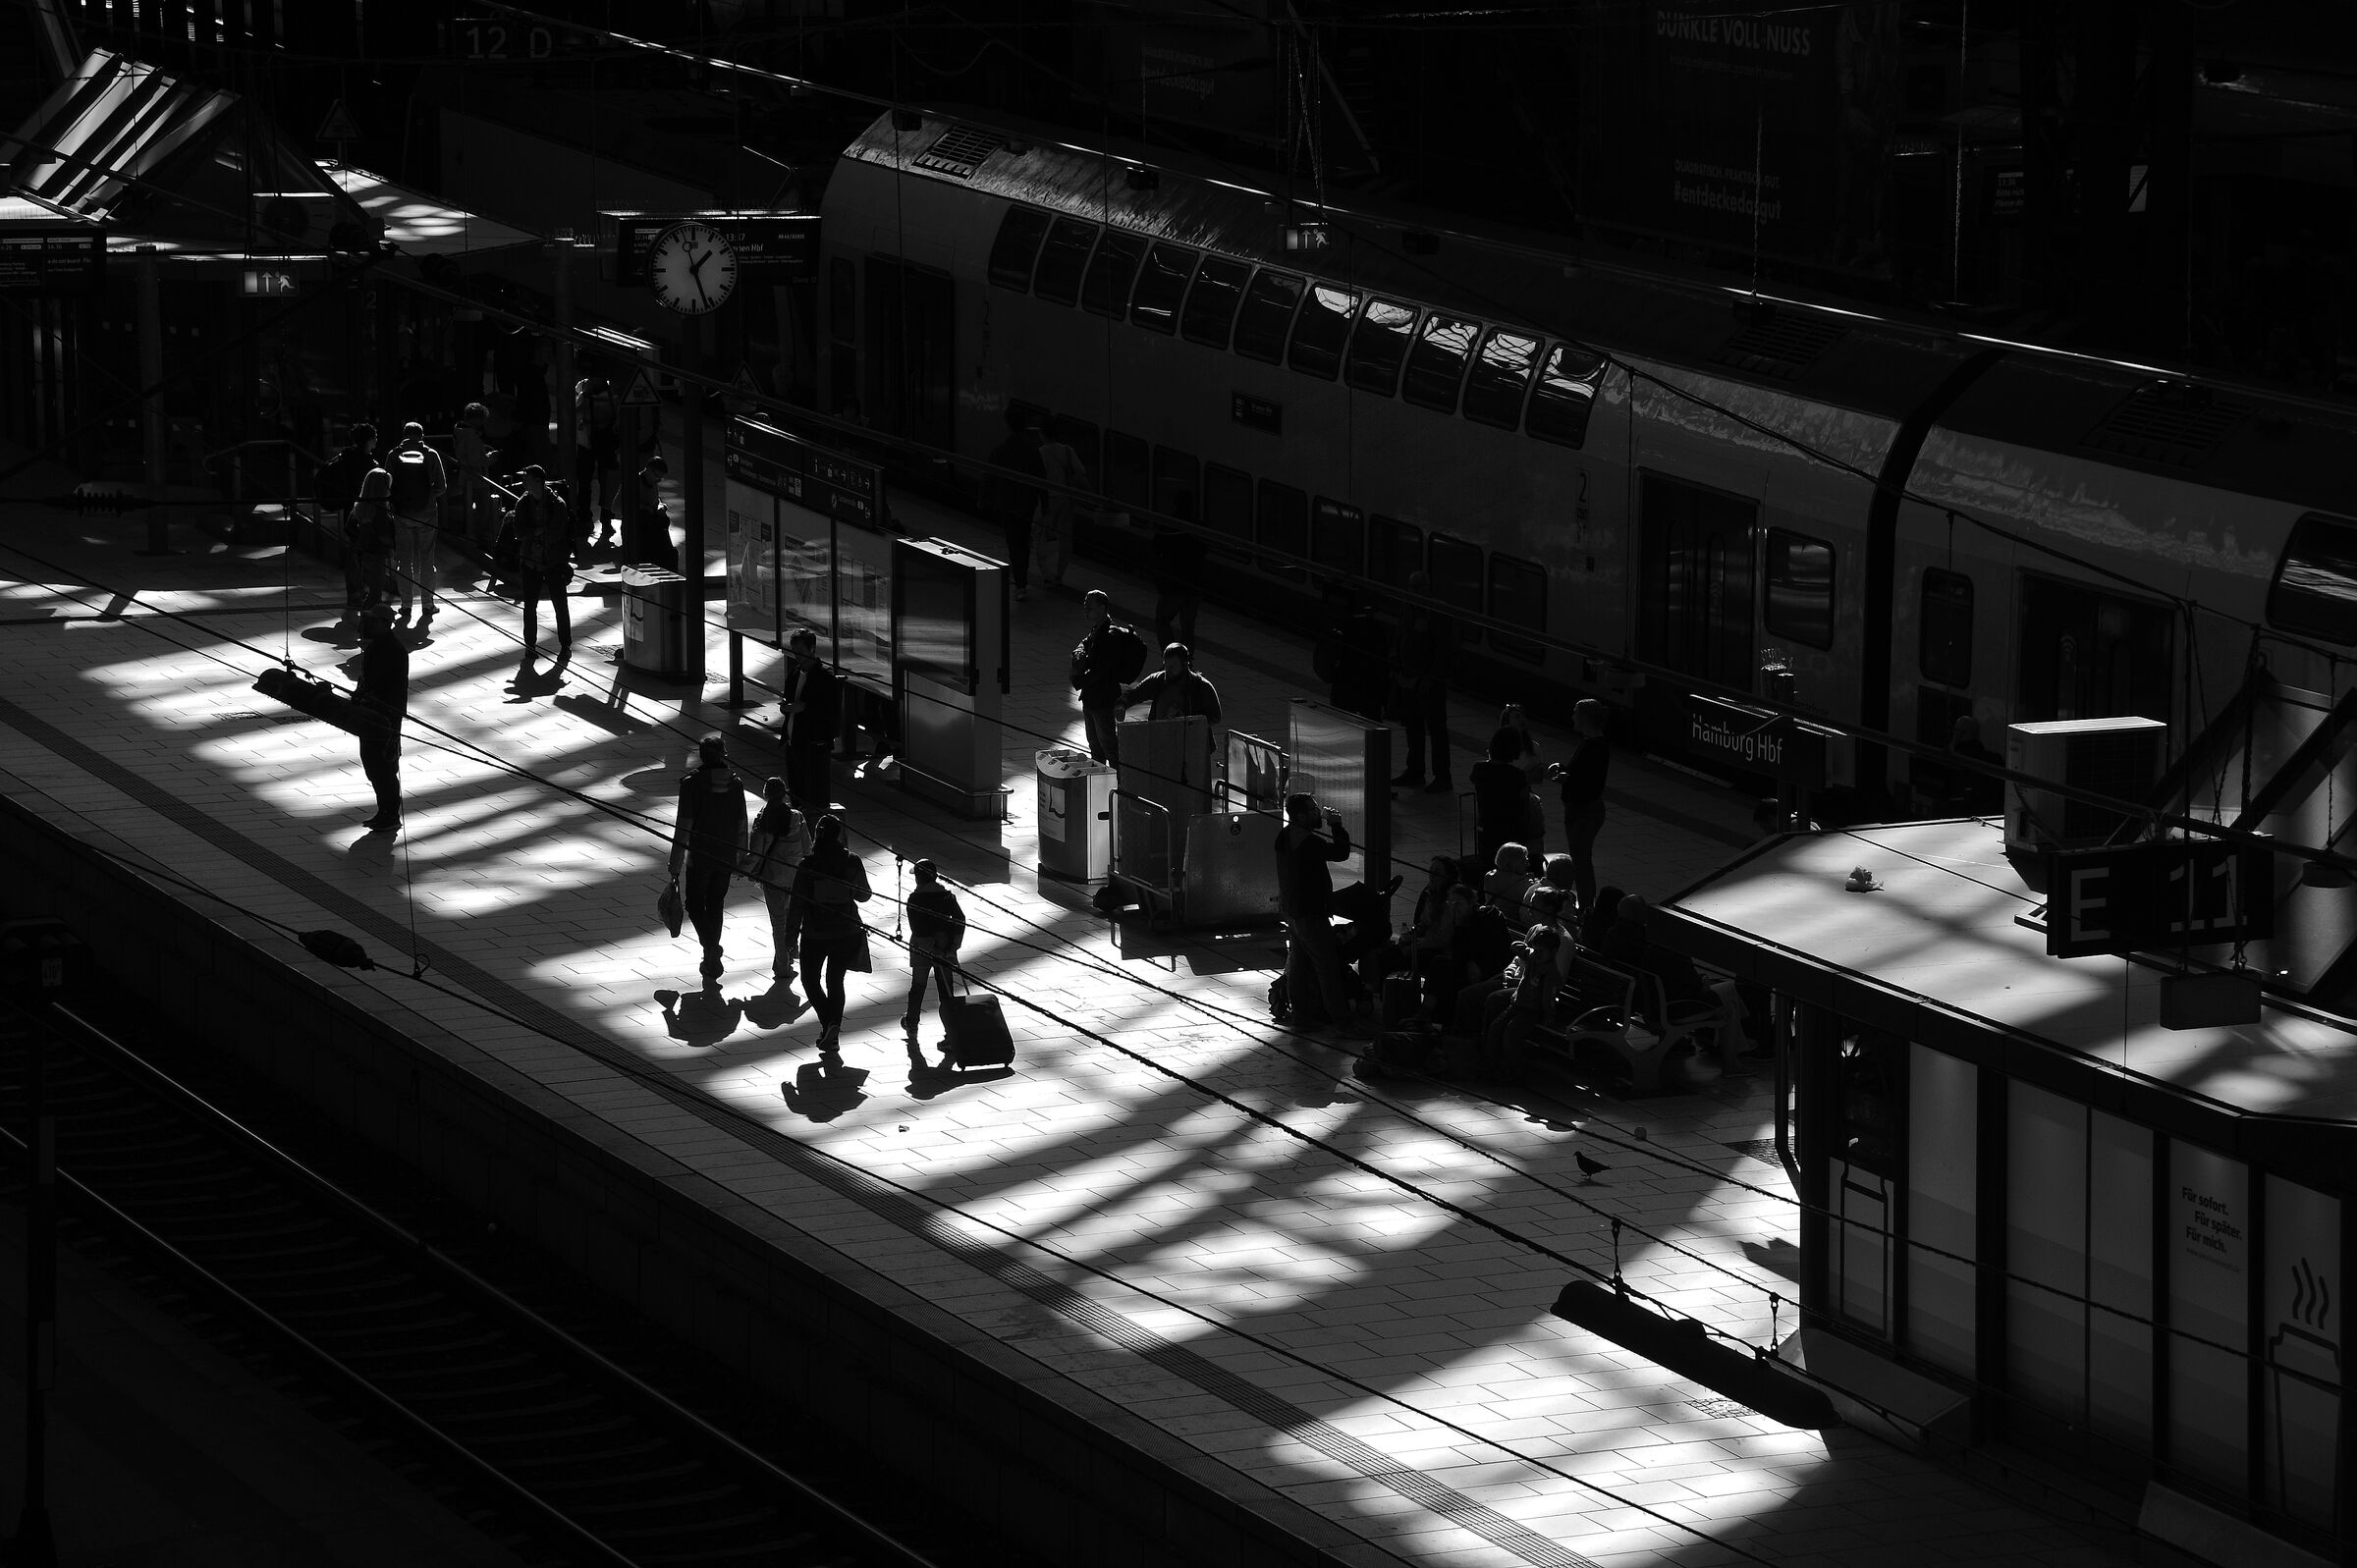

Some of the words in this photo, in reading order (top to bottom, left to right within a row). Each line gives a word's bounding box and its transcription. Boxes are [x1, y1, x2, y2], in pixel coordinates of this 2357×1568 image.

[1658, 10, 1718, 43] DUNKLE
[466, 27, 507, 59] 12
[530, 27, 552, 59] D
[1579, 472, 1587, 503] 2
[1692, 713, 1754, 762] Hamburg
[1757, 732, 1783, 765] Hbf
[2070, 866, 2110, 943] E
[2168, 854, 2248, 934] 11
[2182, 1185, 2197, 1203] Für
[2198, 1195, 2229, 1217] sofort.
[2186, 1224, 2201, 1242] Für
[2203, 1234, 2227, 1254] mich.
[2194, 1210, 2210, 1227] Für
[2211, 1218, 2243, 1241] später.
